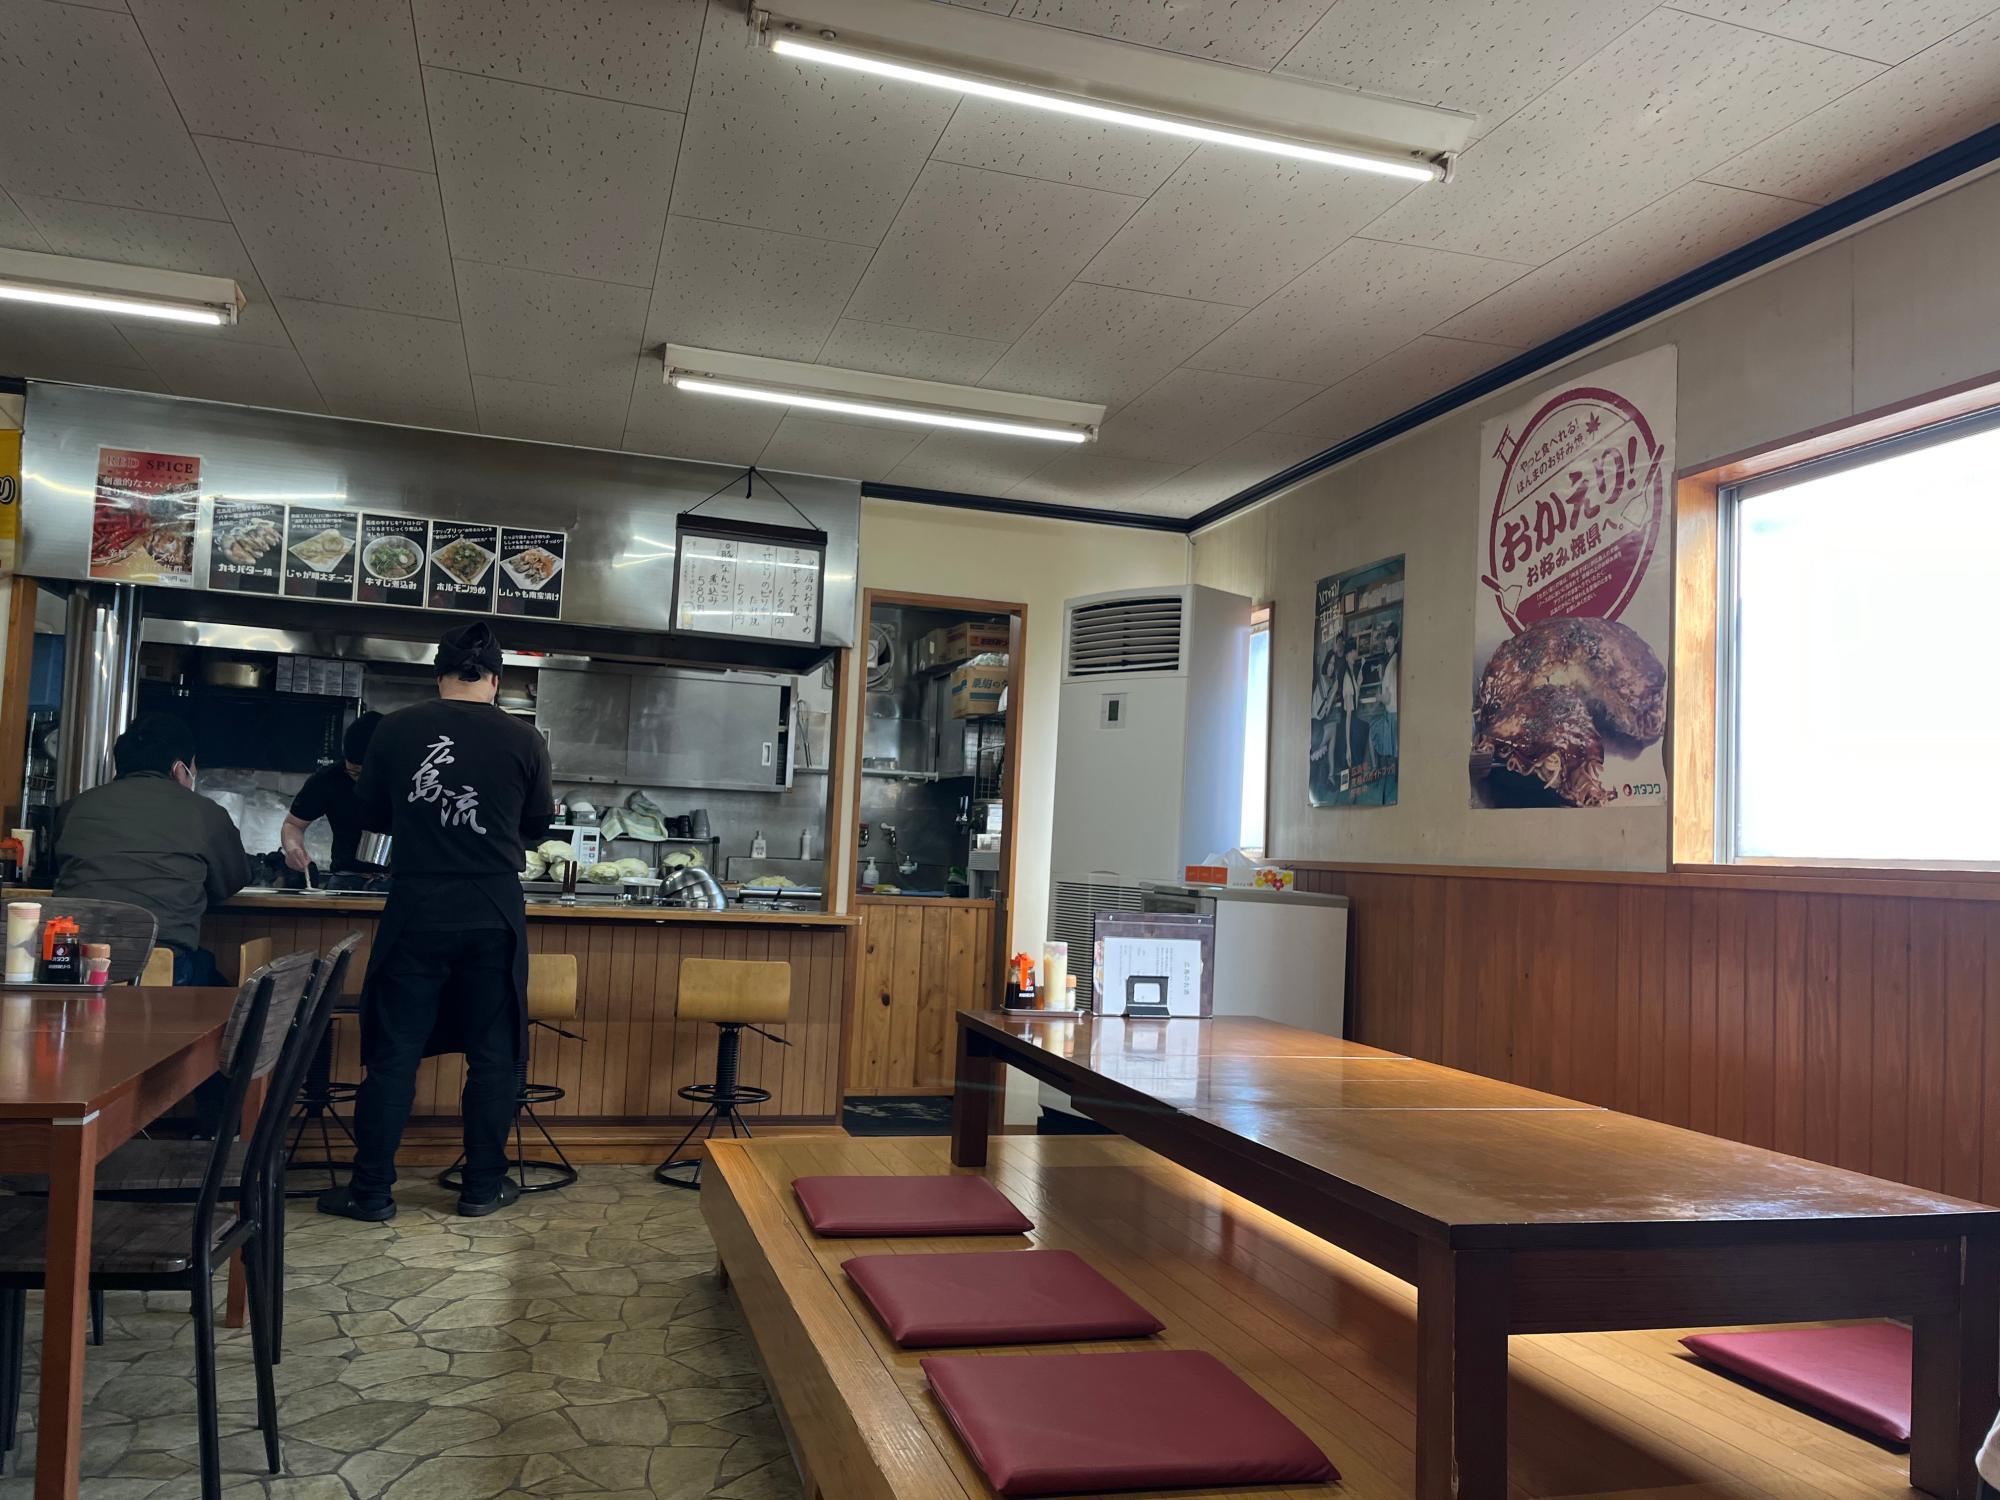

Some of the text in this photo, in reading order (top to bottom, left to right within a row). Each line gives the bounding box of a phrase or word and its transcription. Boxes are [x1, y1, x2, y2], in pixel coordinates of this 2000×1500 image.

[146, 460, 194, 474] SPICE
[1500, 435, 1638, 573] おかえり!
[217, 563, 273, 577] カキバター焼
[286, 569, 353, 585] じゃが明太チーズ
[365, 577, 417, 590] 牛すじ煮込み
[436, 582, 487, 595] ホルモン炒め
[498, 587, 560, 602] ししゃも南蛮漬け
[406, 734, 487, 835] 広島流
[1632, 783, 1661, 795] オタフク
